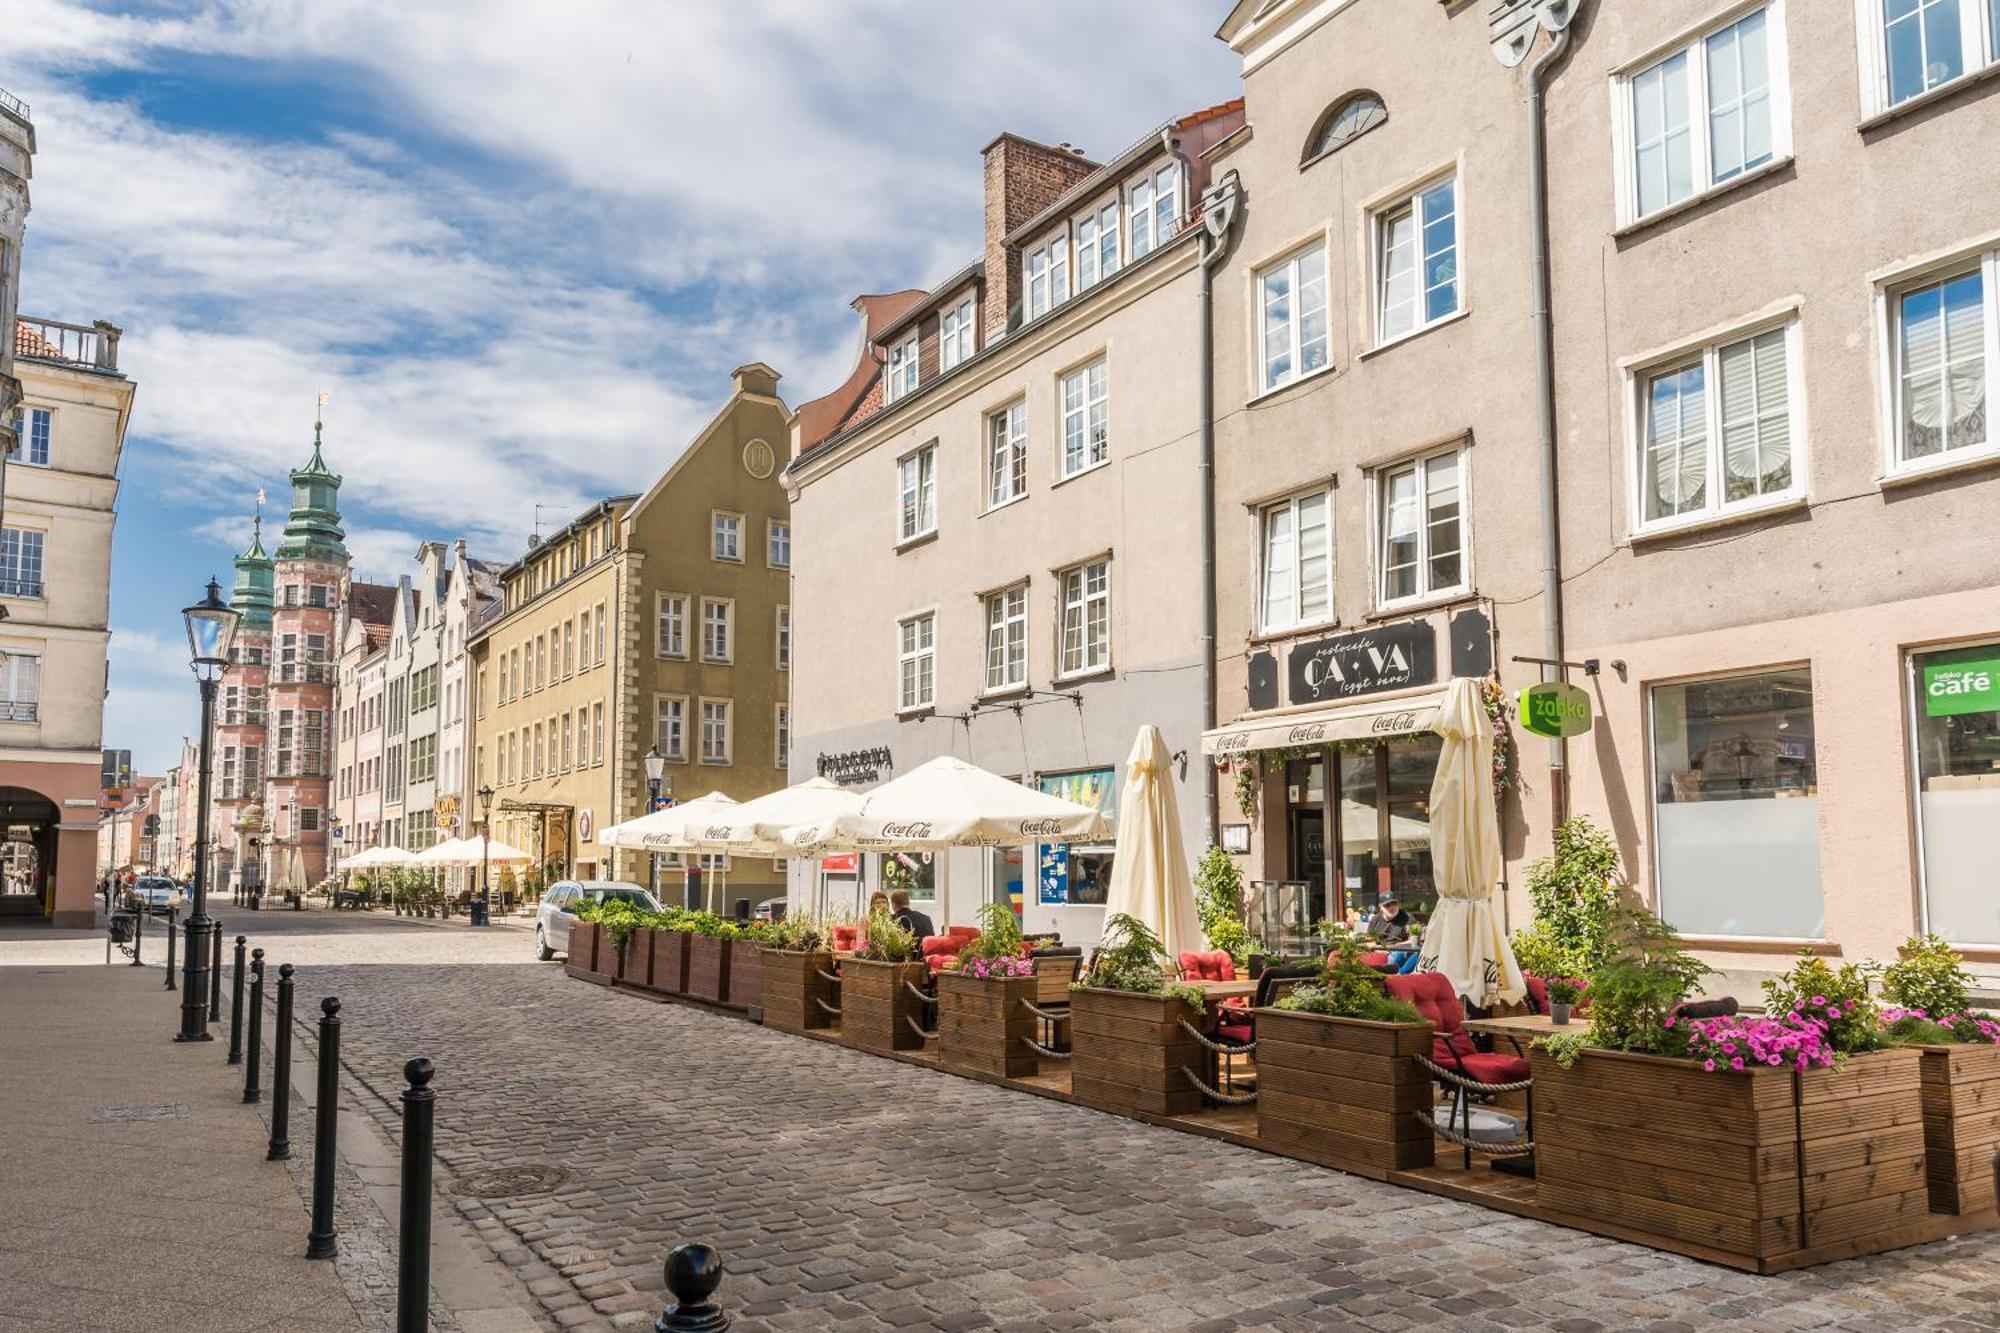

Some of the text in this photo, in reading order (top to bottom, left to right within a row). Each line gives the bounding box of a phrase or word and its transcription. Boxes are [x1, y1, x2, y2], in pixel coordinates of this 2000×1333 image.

[1367, 643, 1409, 675] VA
[1928, 671, 1990, 697] café
[1535, 694, 1586, 719] żabka
